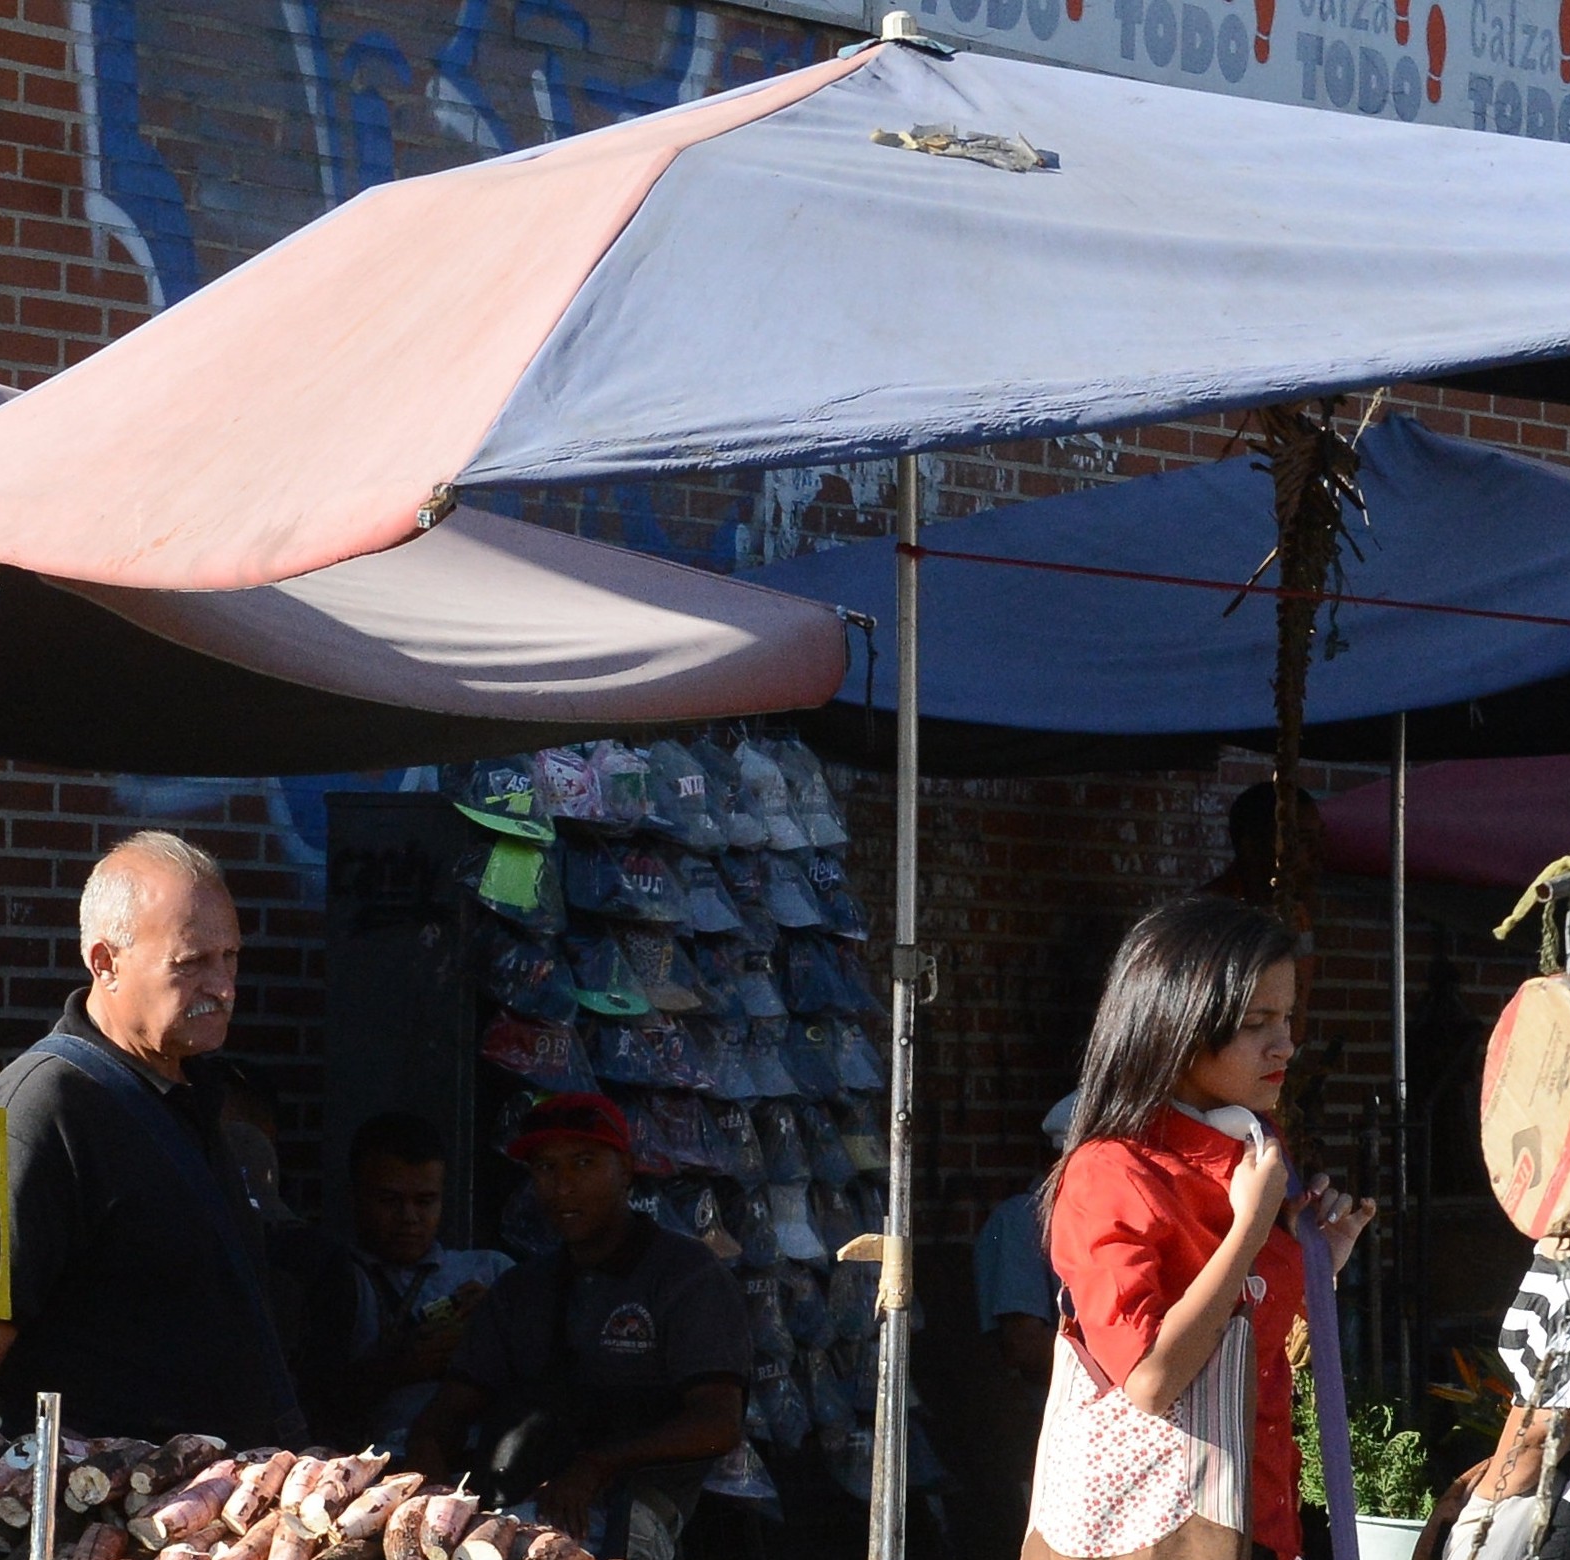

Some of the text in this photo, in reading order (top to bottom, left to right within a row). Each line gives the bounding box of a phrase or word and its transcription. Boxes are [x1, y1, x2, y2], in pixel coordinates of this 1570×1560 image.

[1114, 0, 1249, 83] TODO
[1296, 31, 1422, 122] TODO
[1470, 0, 1555, 75] Calza
